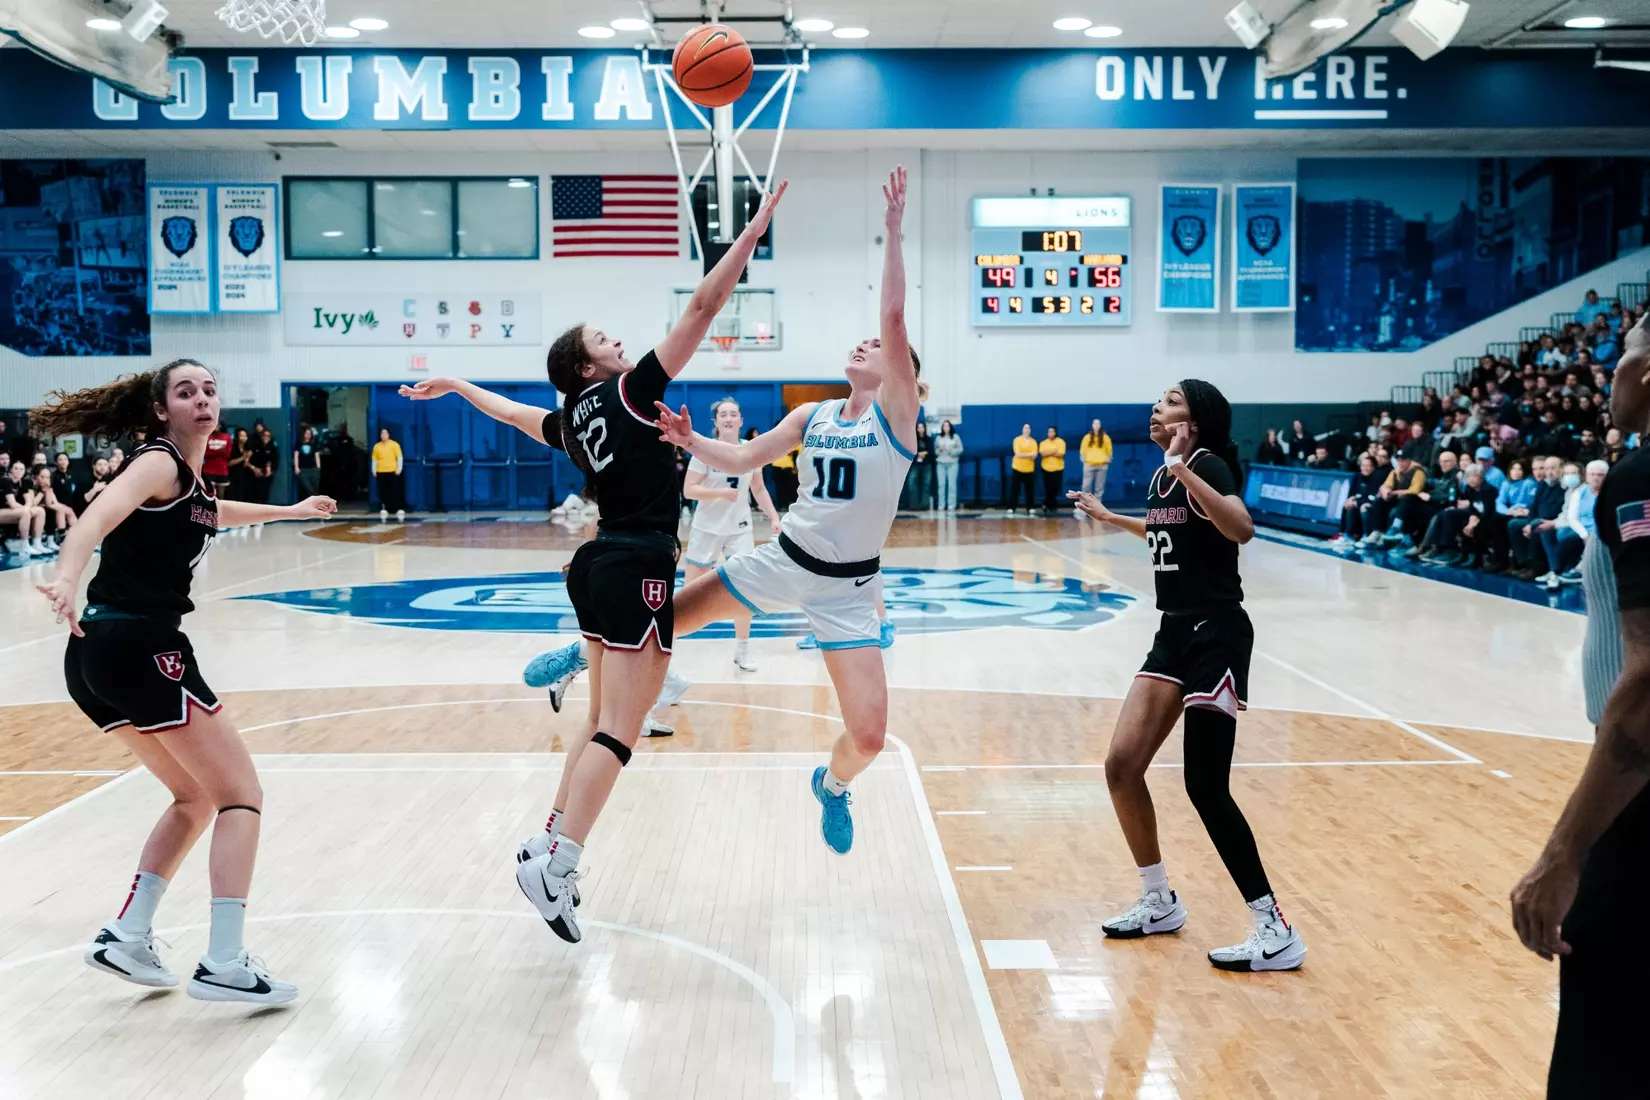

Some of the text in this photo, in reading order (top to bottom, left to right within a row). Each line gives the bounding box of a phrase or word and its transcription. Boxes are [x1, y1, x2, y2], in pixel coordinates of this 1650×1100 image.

[1096, 56, 1227, 100] ONLY
[1076, 208, 1118, 217] LIONS
[1042, 230, 1082, 252] 1:07
[988, 267, 1015, 288] 49
[1045, 269, 1058, 286] 4
[1094, 267, 1121, 288] 56
[403, 299, 417, 318] C
[987, 298, 999, 312] 4
[1009, 297, 1022, 313] 4
[1080, 296, 1094, 314] 2
[1108, 296, 1121, 313] 2
[313, 308, 355, 334] Ivy
[470, 324, 481, 339] P
[501, 324, 515, 338] Y
[812, 456, 857, 500] 10
[648, 583, 662, 602] H
